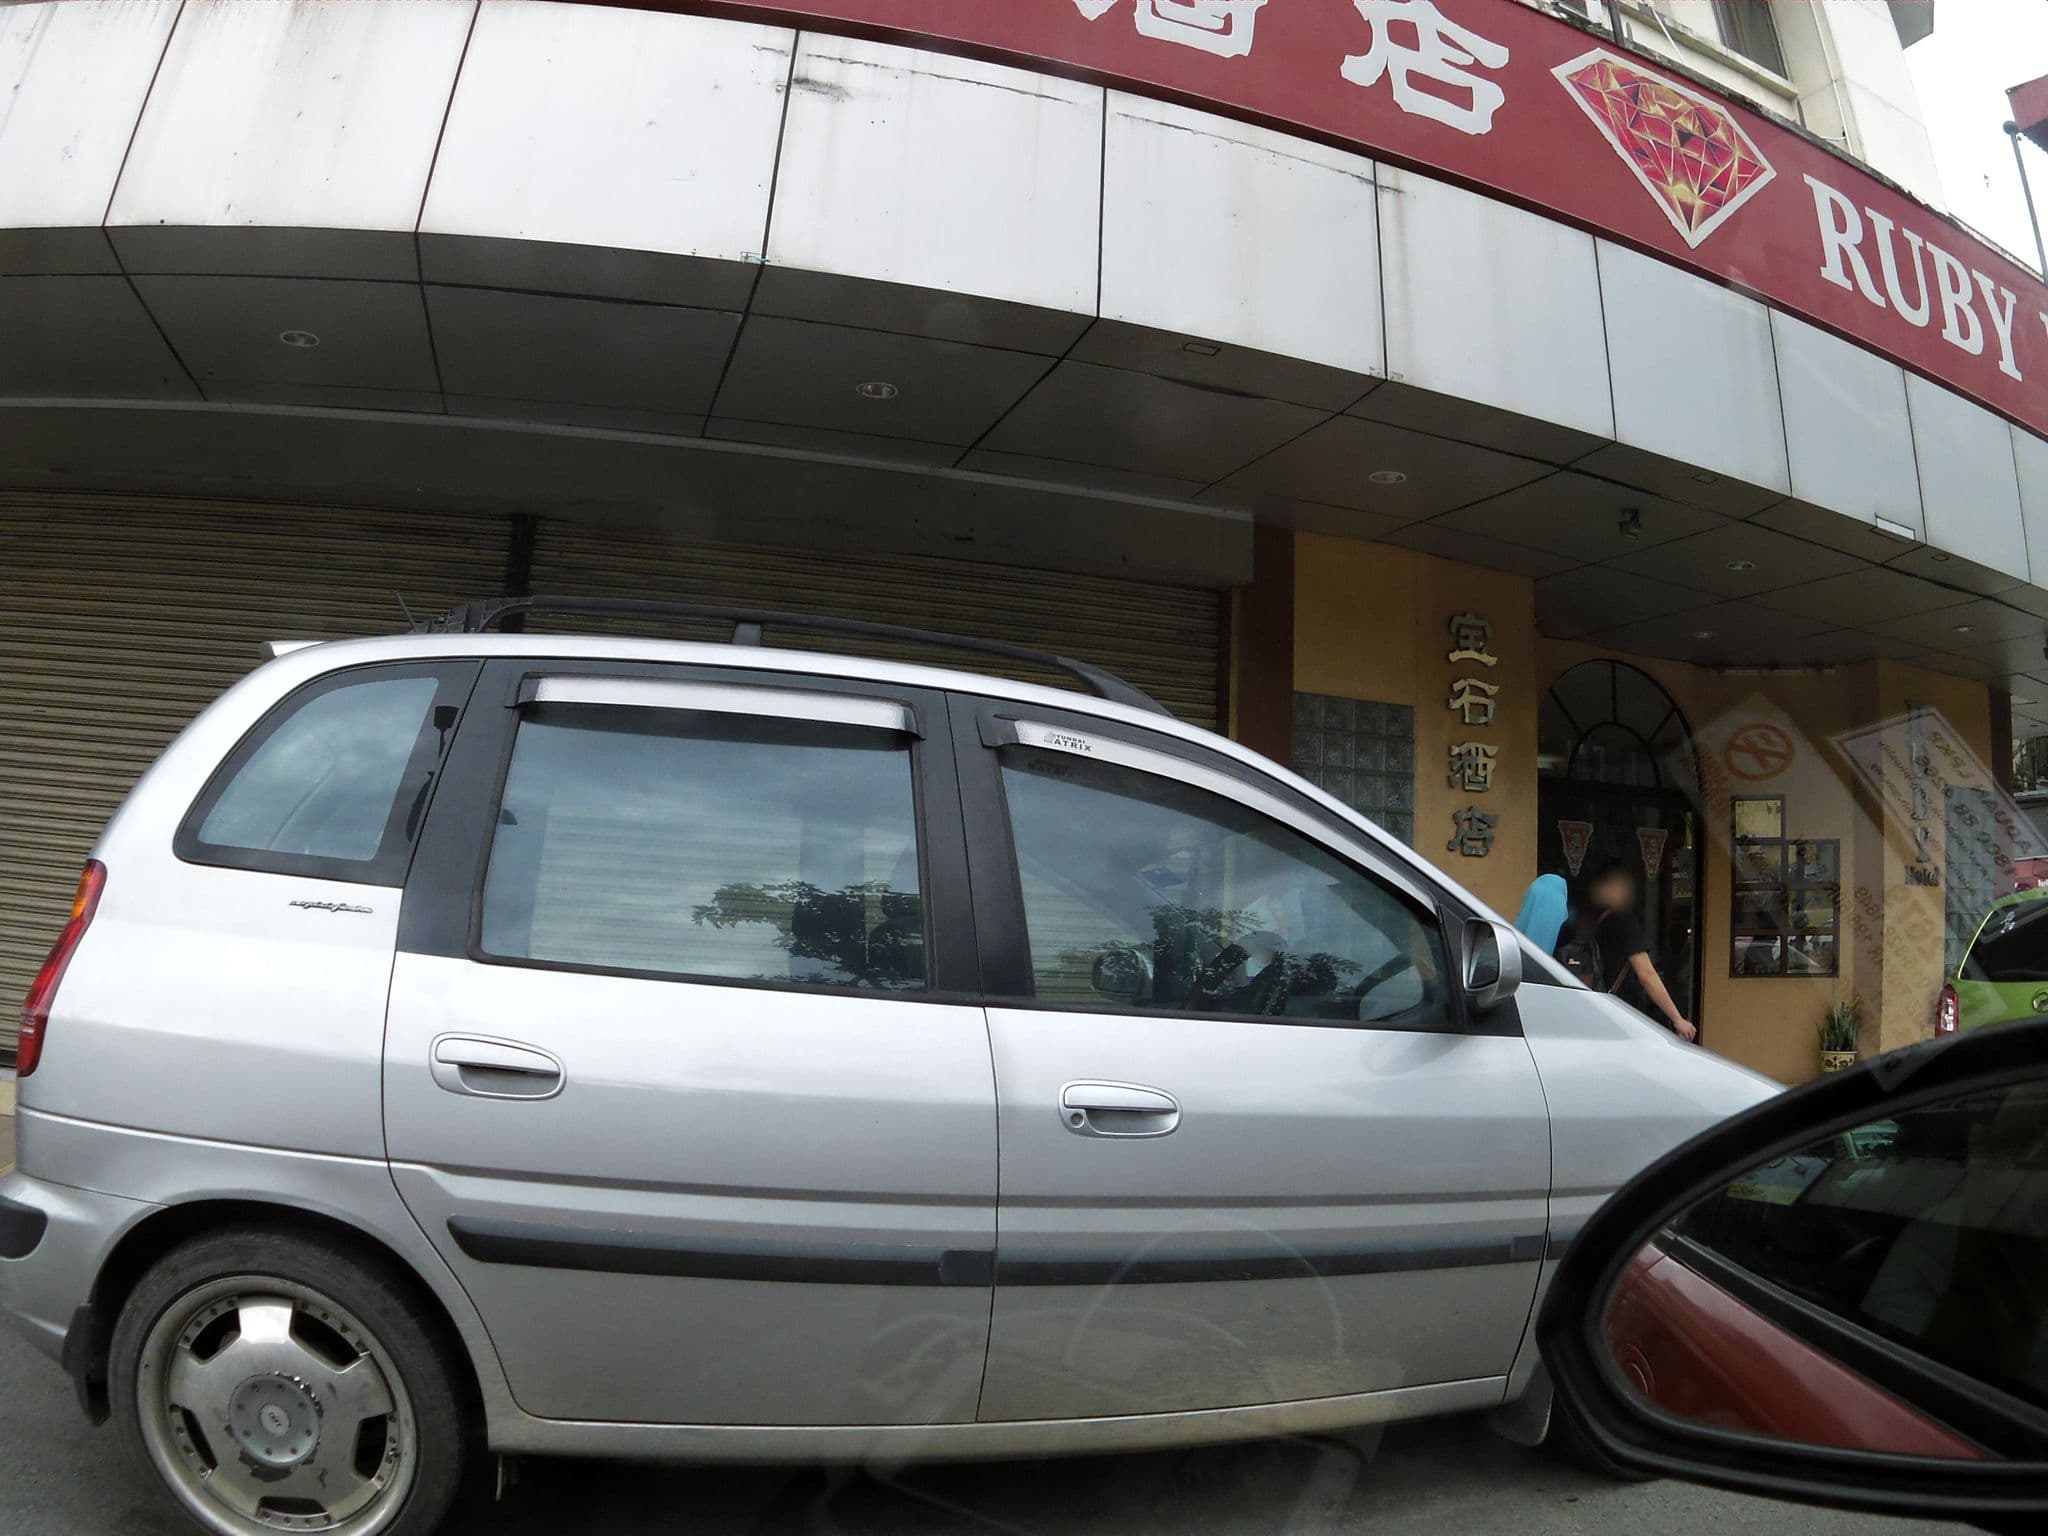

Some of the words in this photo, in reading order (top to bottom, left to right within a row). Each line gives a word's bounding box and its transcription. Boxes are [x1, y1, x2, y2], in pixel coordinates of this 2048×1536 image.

[1803, 173, 2022, 382] RUBY
[1449, 612, 1499, 857] 宝石酒店
